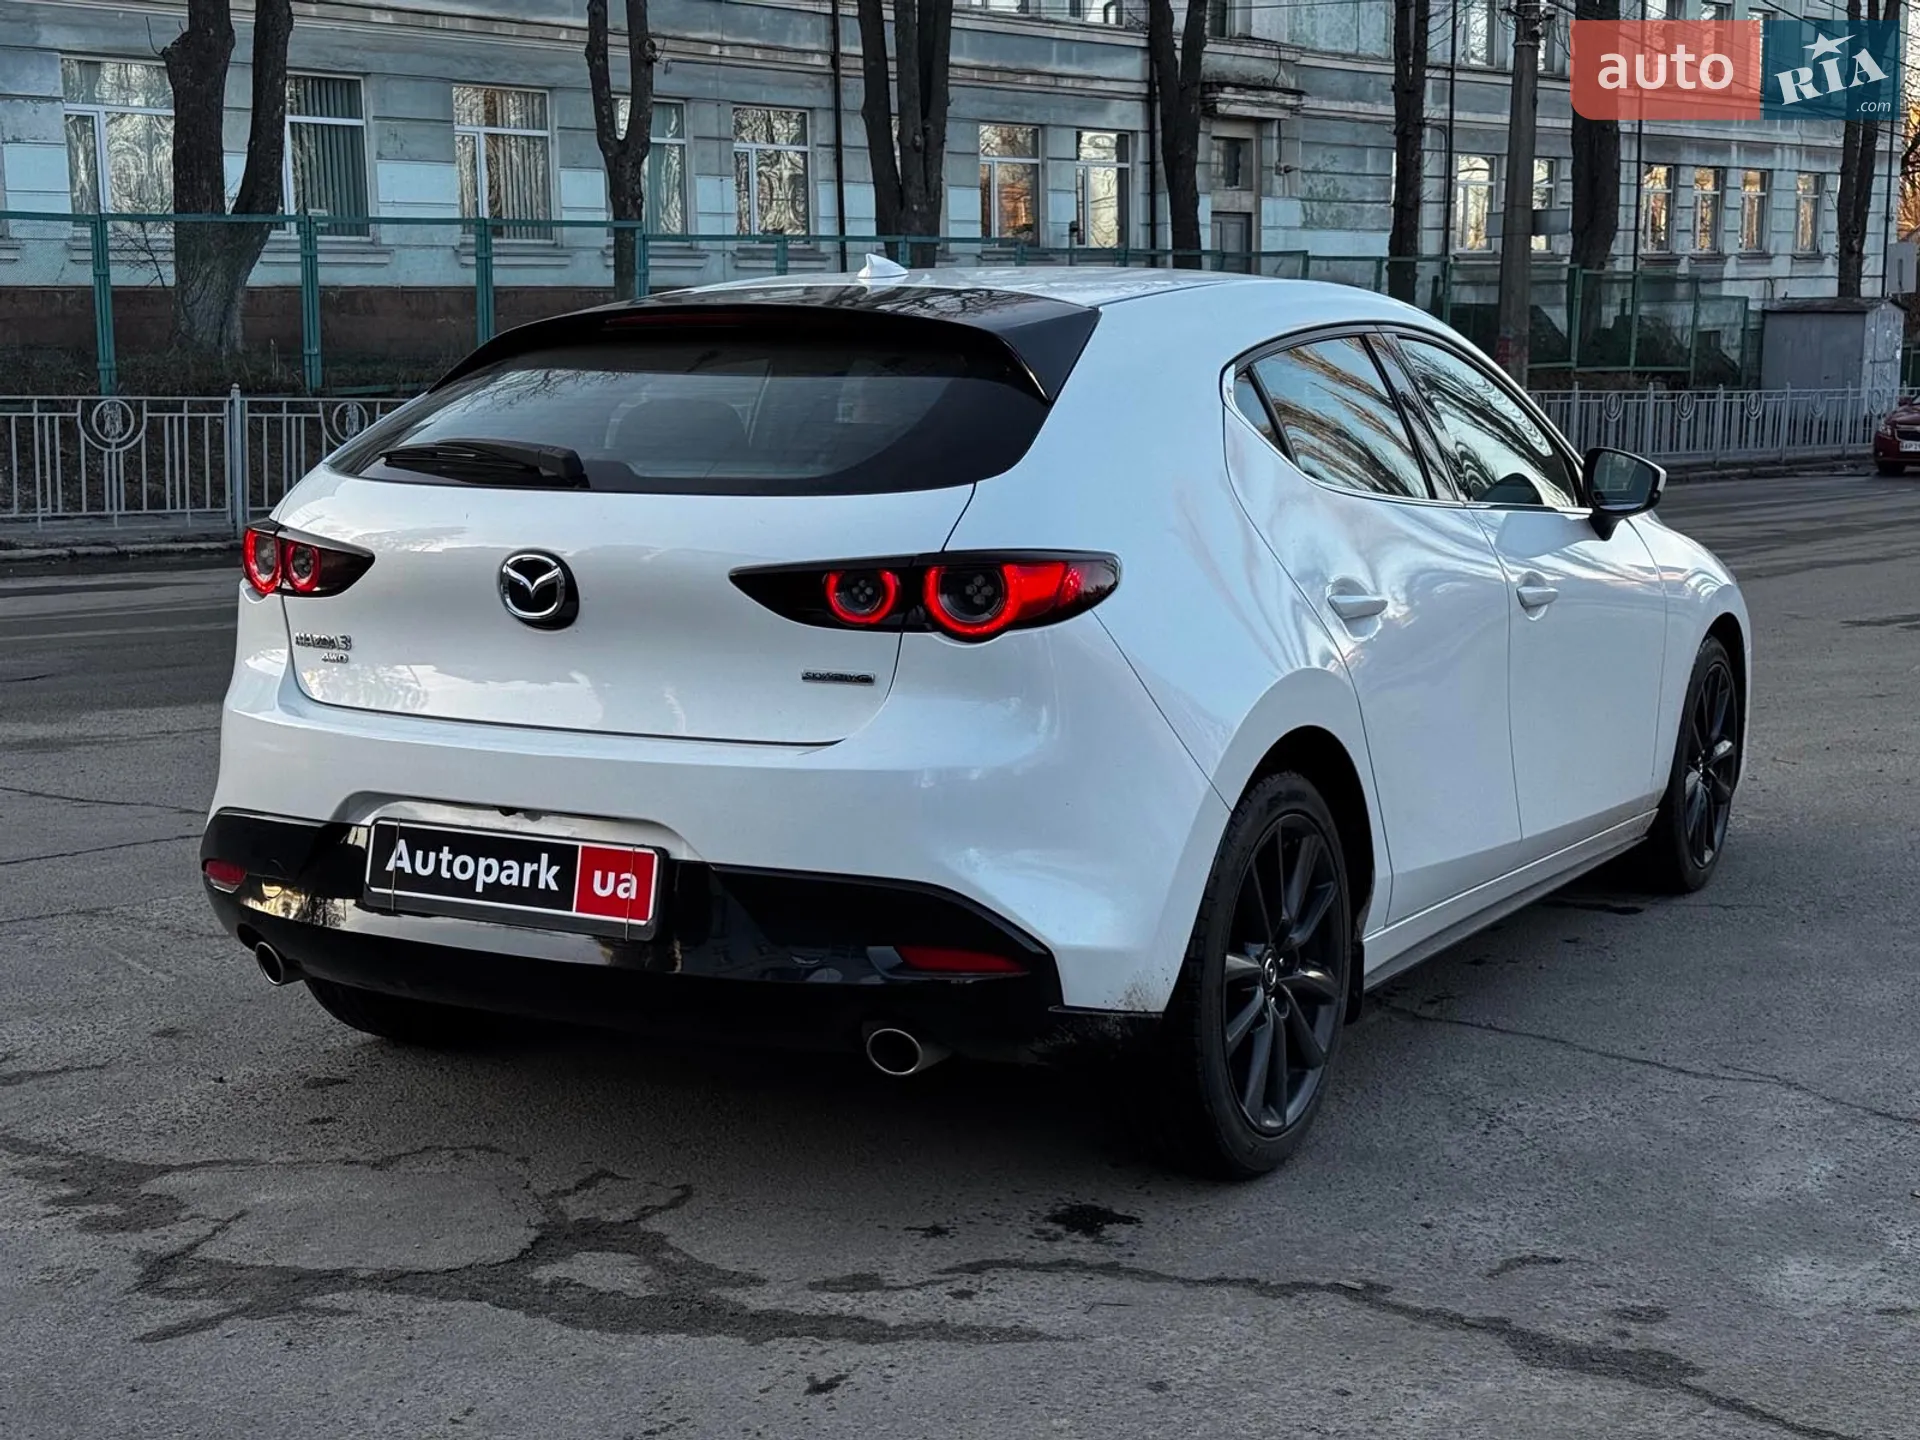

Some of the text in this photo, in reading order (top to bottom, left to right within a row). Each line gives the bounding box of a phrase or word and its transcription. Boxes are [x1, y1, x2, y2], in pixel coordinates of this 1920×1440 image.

[321, 652, 349, 664] AWD
[385, 838, 637, 899] Autopark ua
